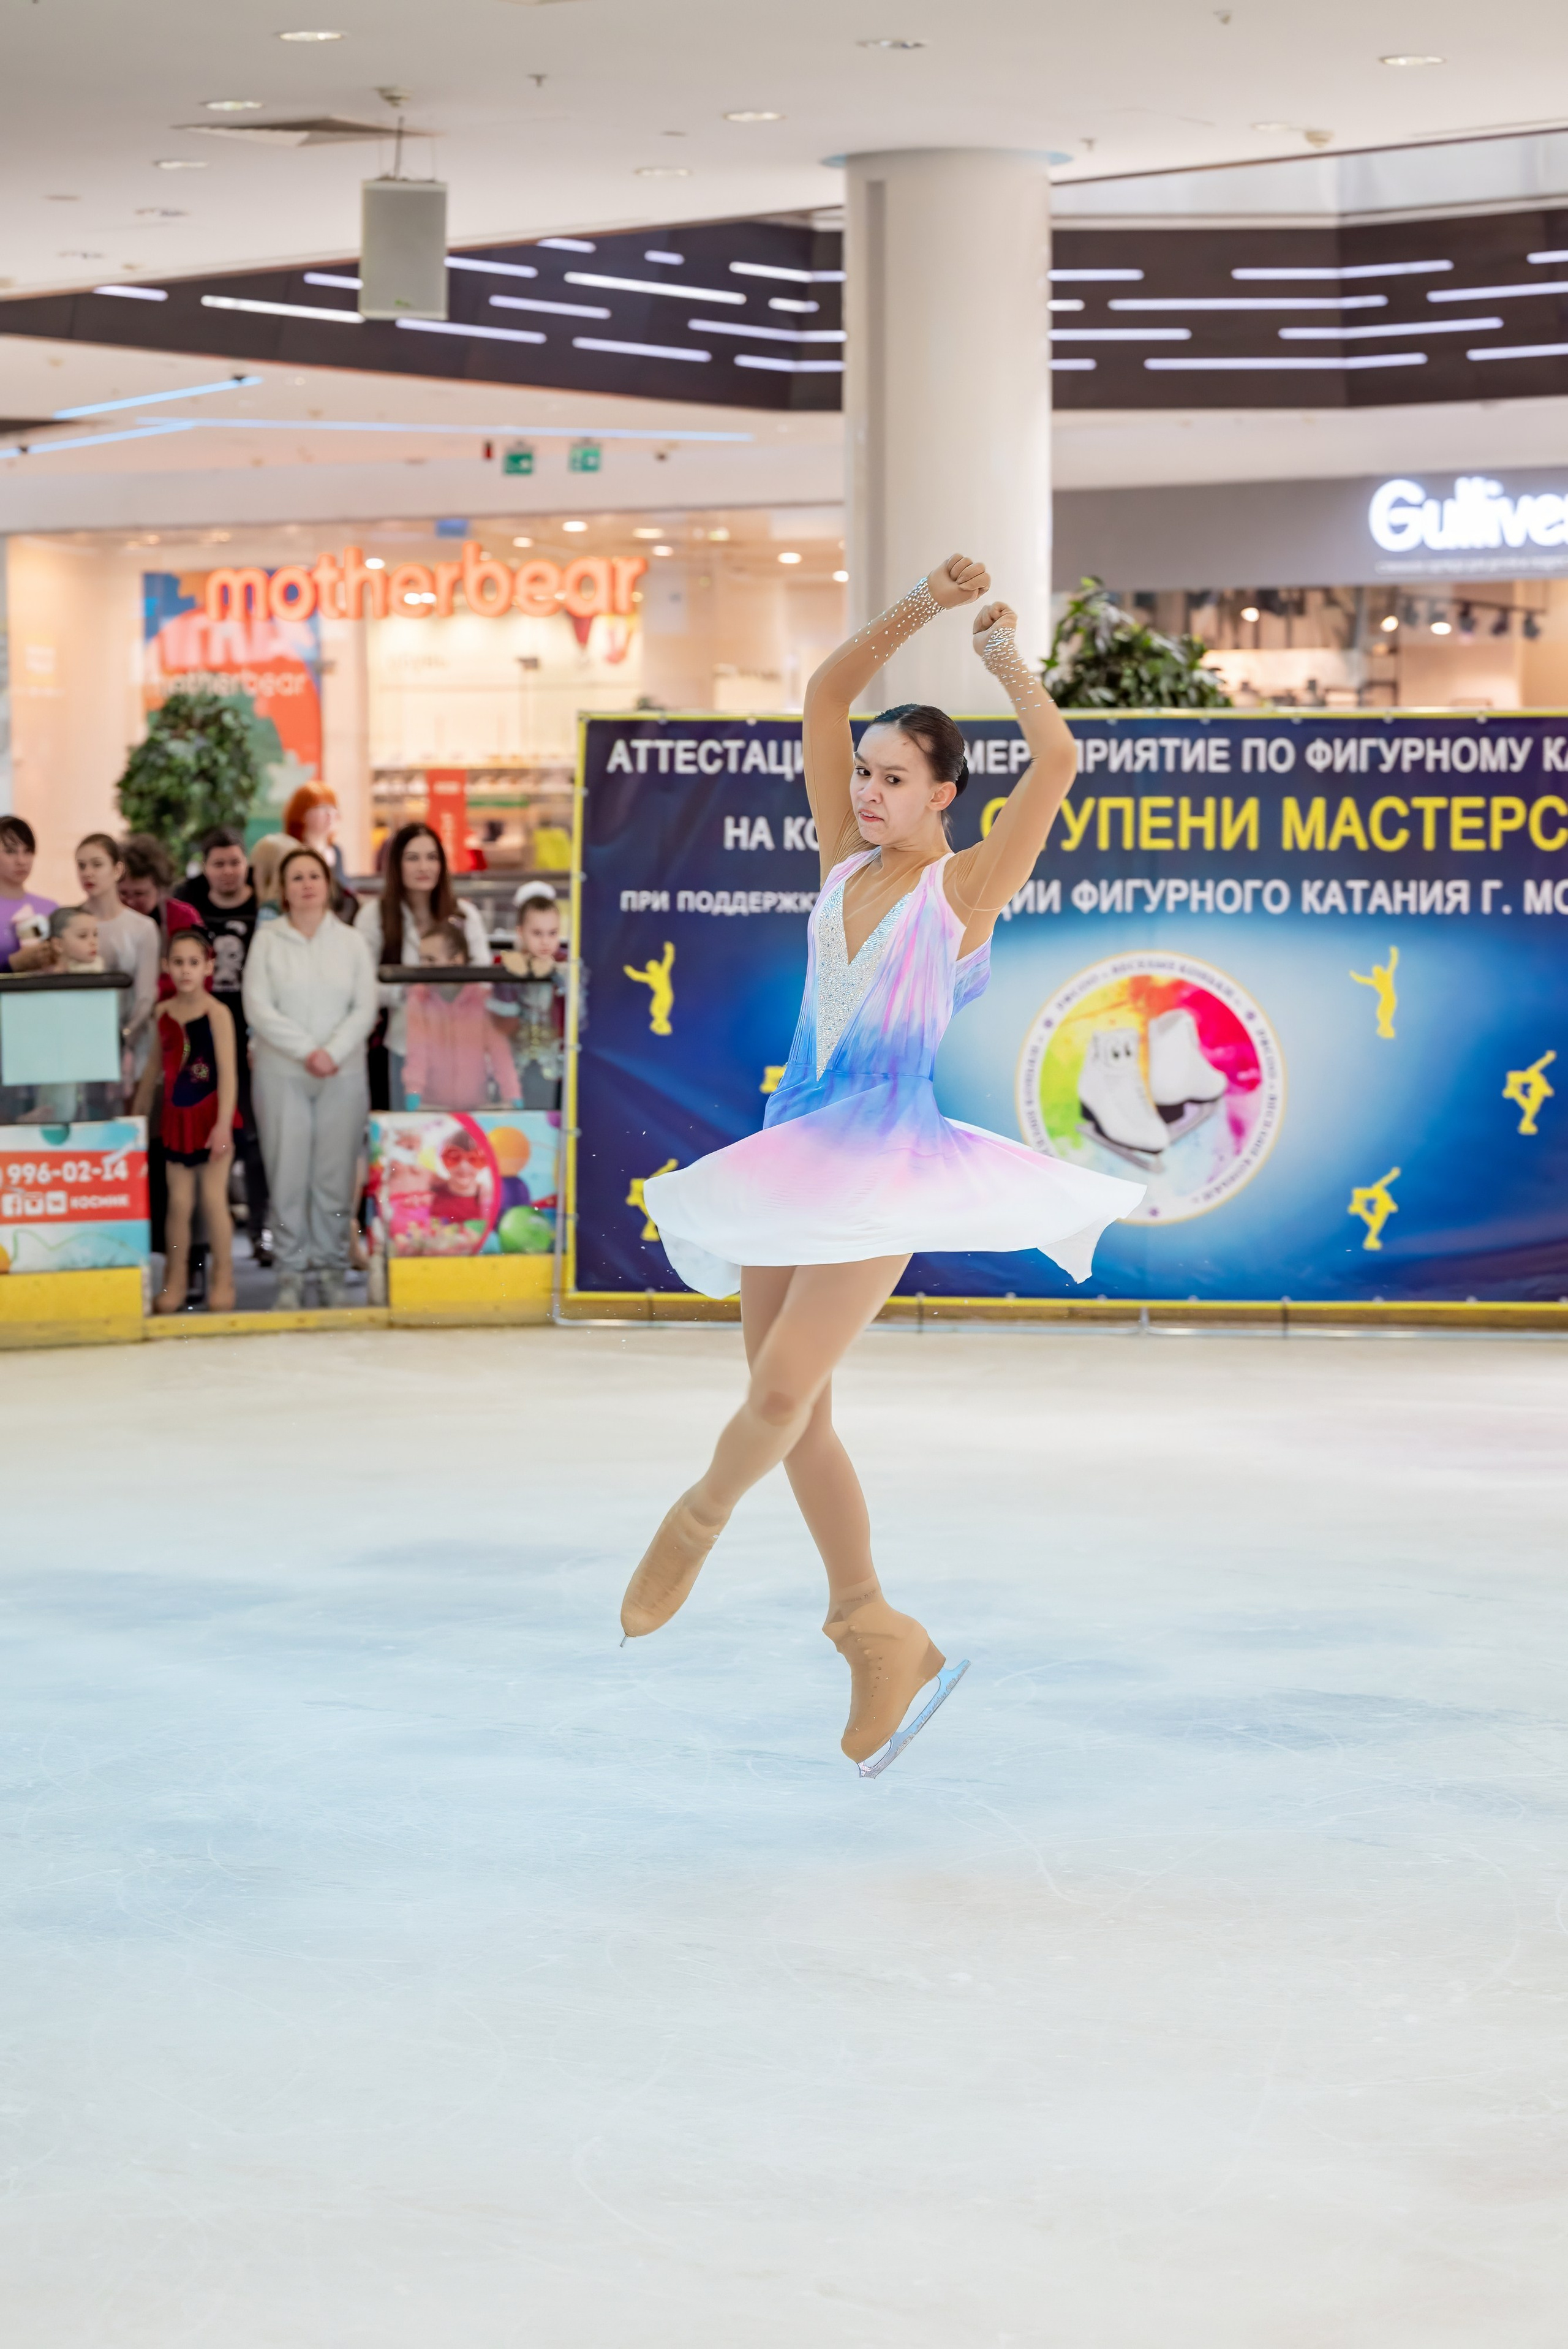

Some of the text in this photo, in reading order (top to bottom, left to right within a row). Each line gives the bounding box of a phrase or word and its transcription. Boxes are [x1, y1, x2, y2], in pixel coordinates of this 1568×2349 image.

[1369, 476, 1568, 552] Gullive
[206, 541, 647, 621] motherbear
[1242, 737, 1295, 774] ПО
[1305, 736, 1533, 774] ФИГУРНОМУ
[1542, 736, 1568, 772] К
[723, 816, 775, 851] НА
[980, 796, 1259, 851] СУПЕНИ
[1282, 795, 1568, 851] МАСТЕРС
[620, 891, 670, 913] ПРИ
[1071, 878, 1291, 914] ФИГУРНОГО
[1302, 879, 1470, 915] КАТАНИЯ
[1481, 879, 1512, 915] Г.
[7, 1159, 129, 1185] 996-02-14
